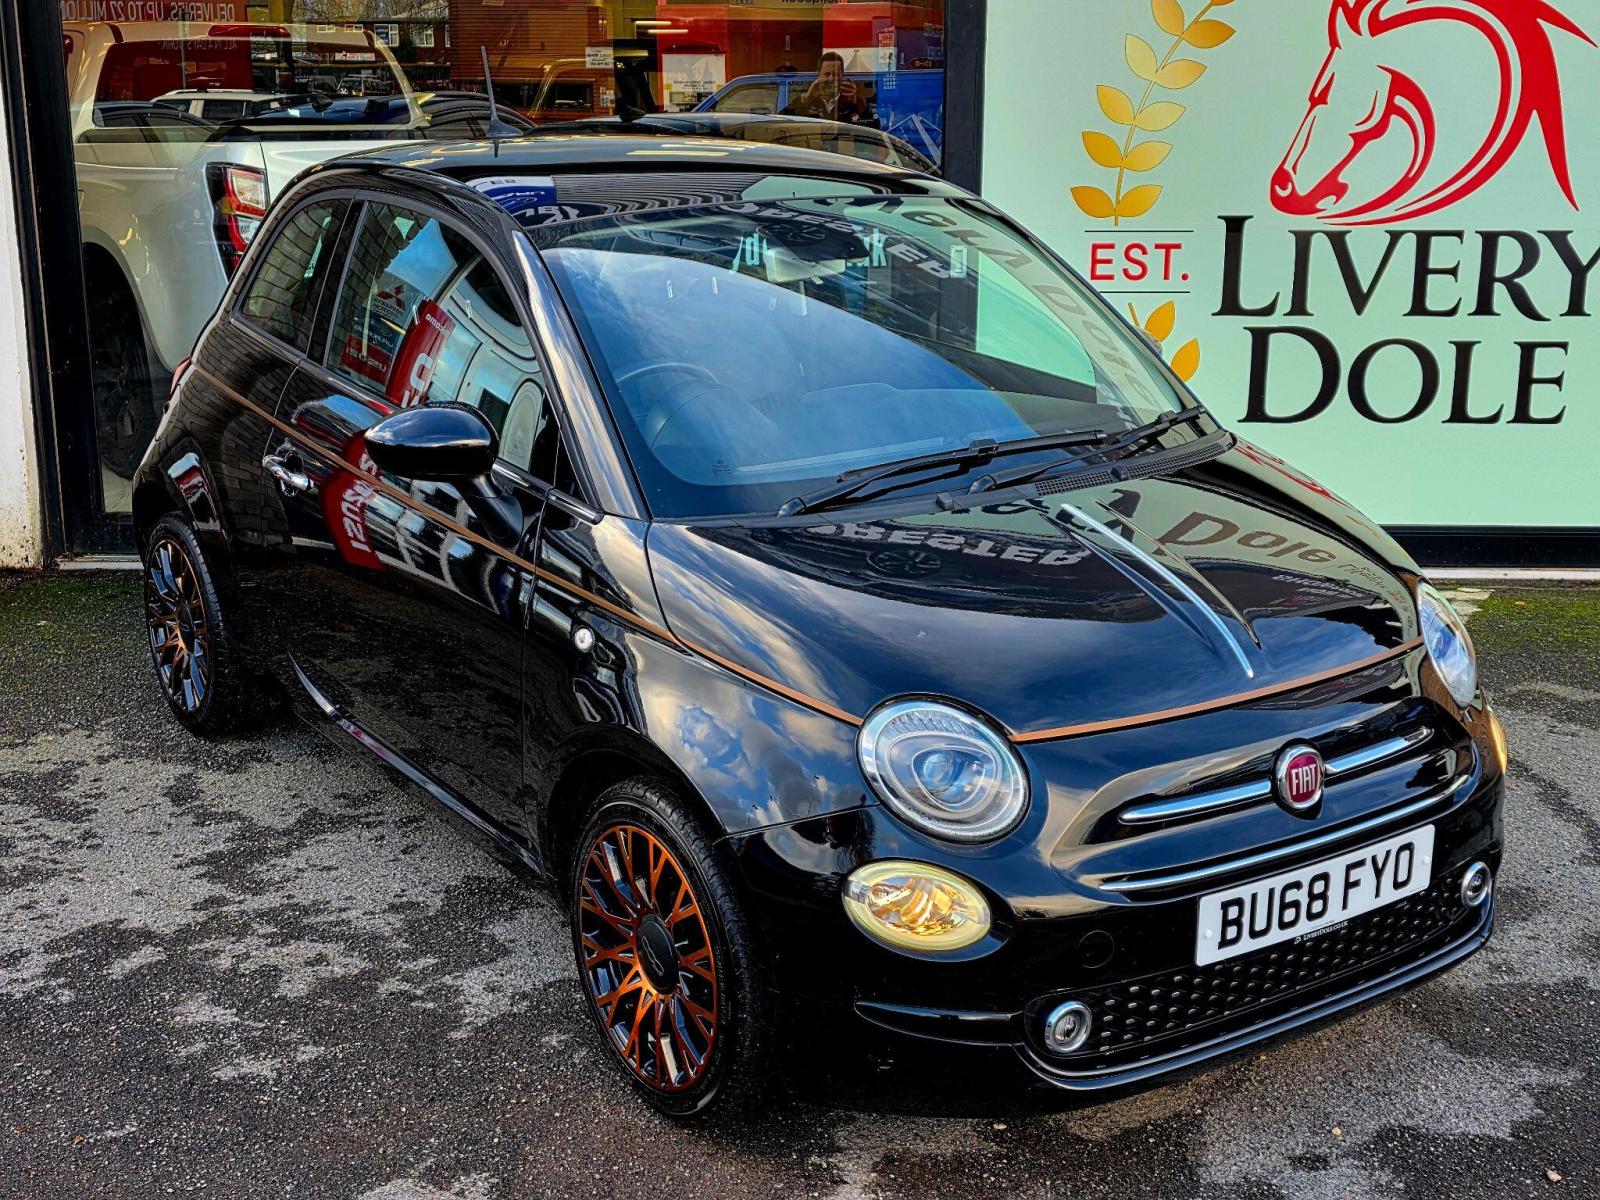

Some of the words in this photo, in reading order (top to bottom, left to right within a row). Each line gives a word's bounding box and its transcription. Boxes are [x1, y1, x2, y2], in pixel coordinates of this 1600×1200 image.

[1089, 242, 1190, 282] EST.
[1211, 214, 1600, 322] LIVERY
[1237, 325, 1570, 425] DOLE
[1291, 763, 1317, 796] FIAT
[1218, 871, 1331, 950] BU68
